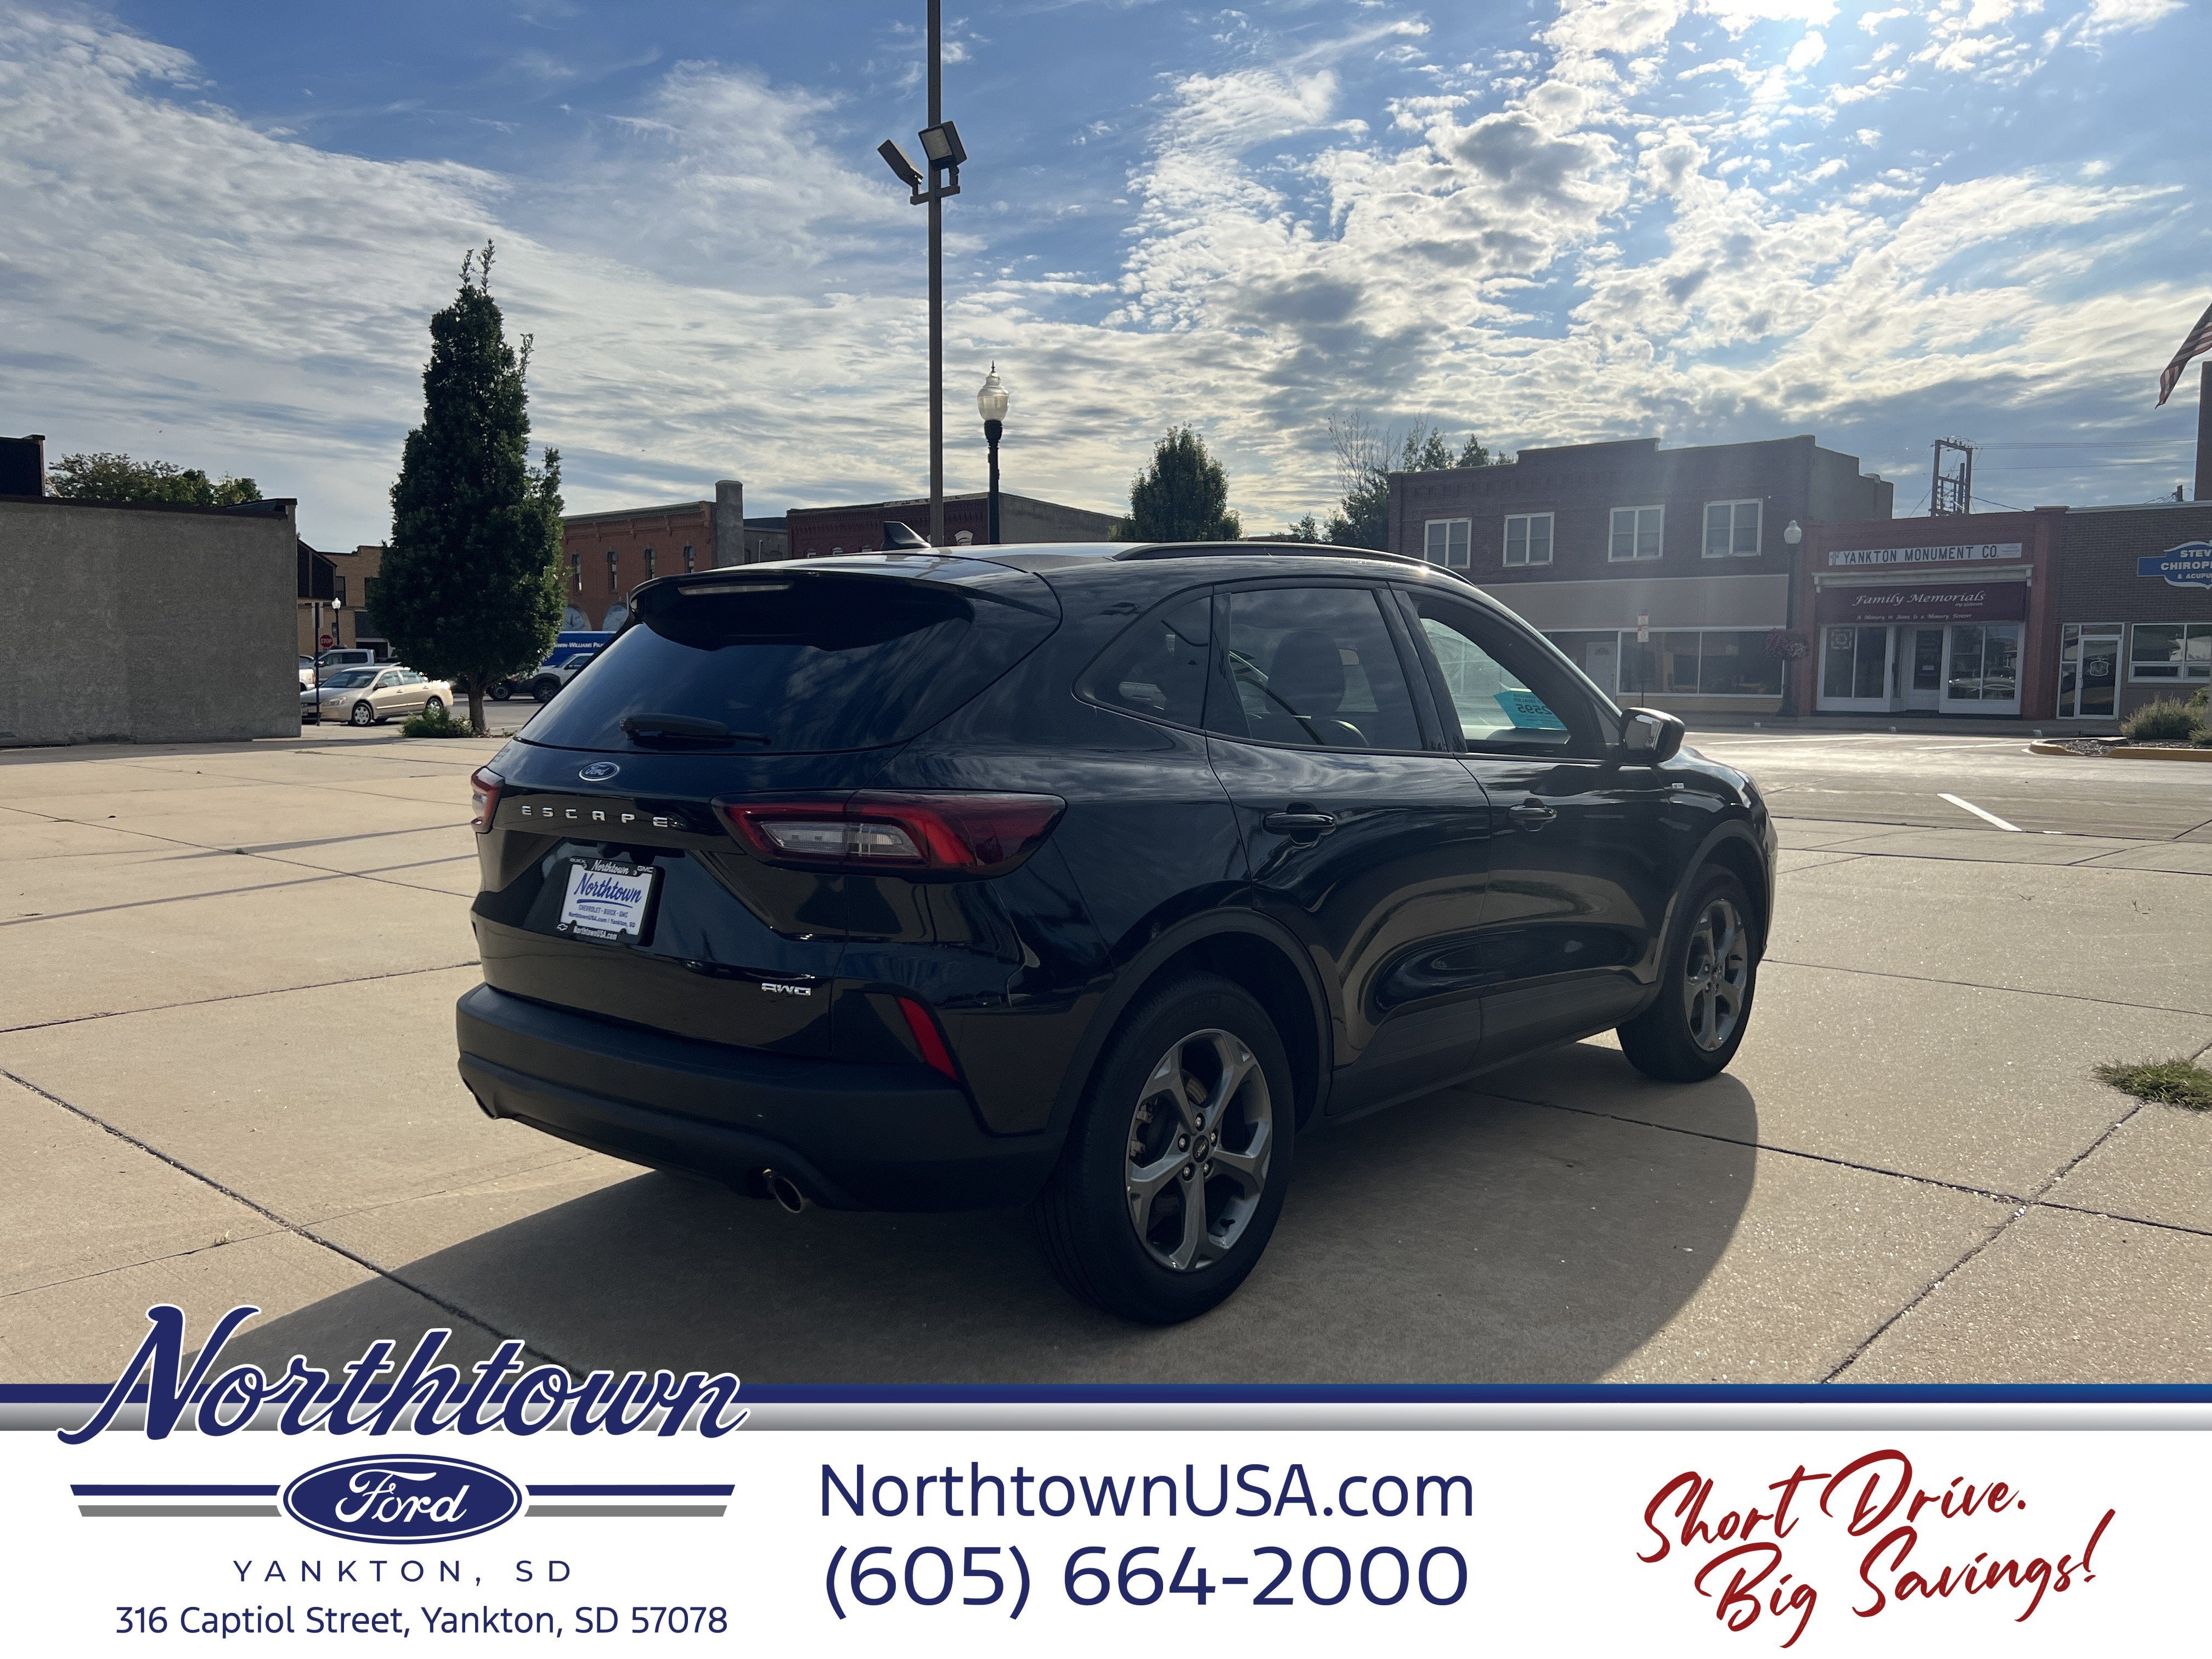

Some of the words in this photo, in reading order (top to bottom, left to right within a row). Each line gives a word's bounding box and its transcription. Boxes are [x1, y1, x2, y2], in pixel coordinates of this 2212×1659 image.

[1843, 550, 1897, 564] YANKTON
[1904, 546, 1974, 561] MONUMENT
[1982, 545, 1999, 558] CO.
[2180, 549, 2212, 558] STEV
[1852, 593, 1904, 606] Family
[1906, 590, 1986, 603] Memorials
[585, 764, 610, 775] Ford
[522, 806, 668, 827] ESCAPE
[591, 859, 630, 874] Northtown
[574, 872, 642, 903] Northtown
[579, 905, 601, 913] CHEVROLET
[569, 911, 607, 922] NorthtownUSA.com
[573, 926, 618, 940] NorthtownUSA.com
[761, 983, 811, 996] AWD
